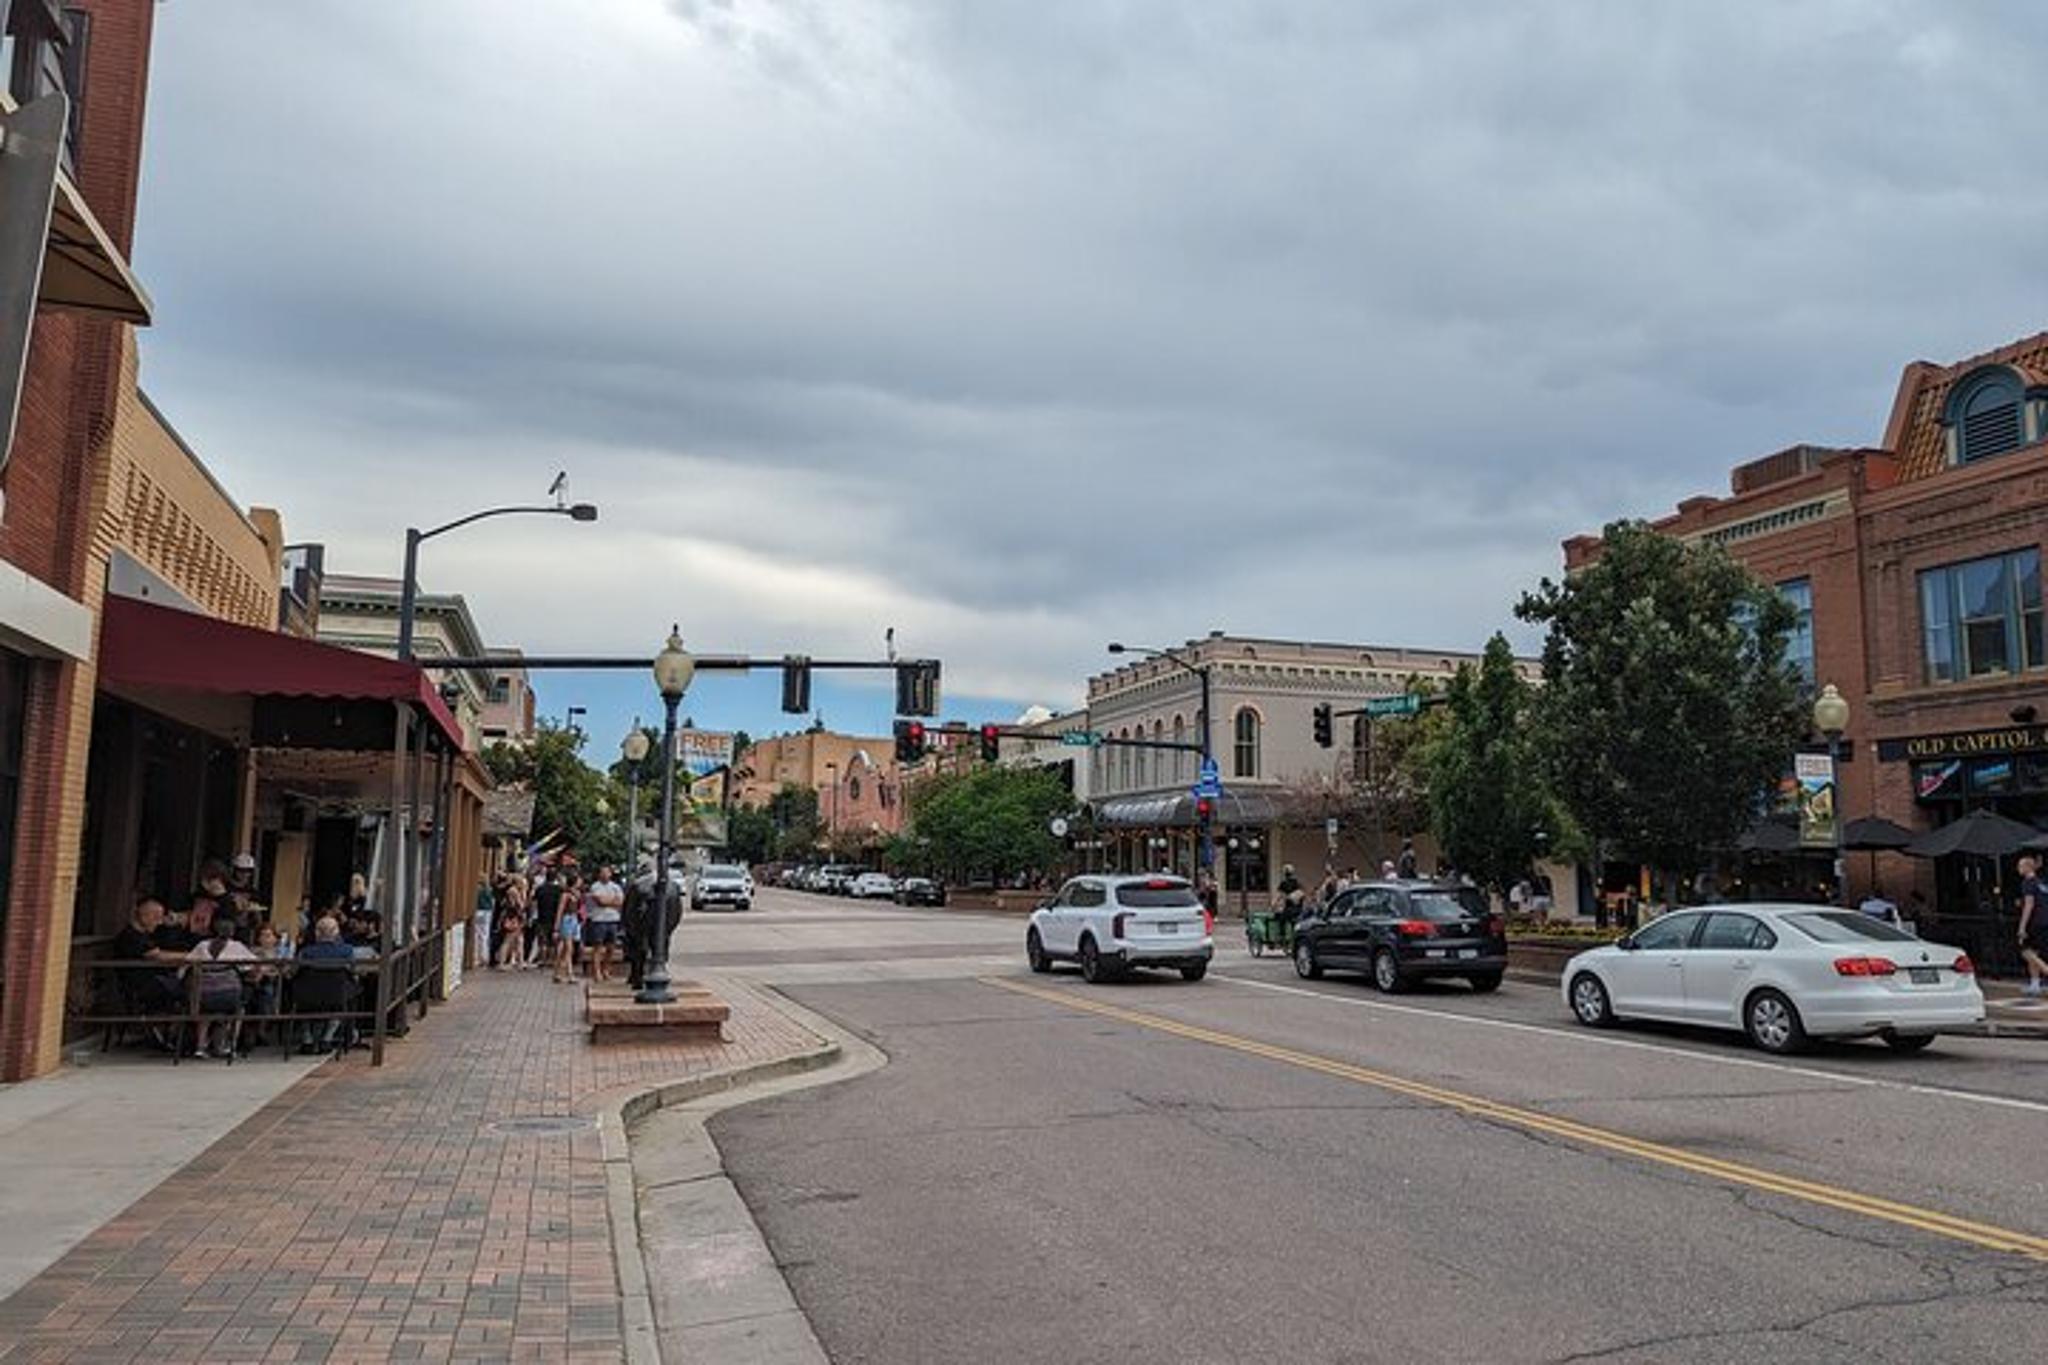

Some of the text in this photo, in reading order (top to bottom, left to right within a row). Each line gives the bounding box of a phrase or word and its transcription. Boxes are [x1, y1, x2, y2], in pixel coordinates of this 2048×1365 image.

[682, 733, 729, 750] FREE
[1907, 738, 1945, 755] OLD
[1953, 730, 2035, 752] CAPITOL
